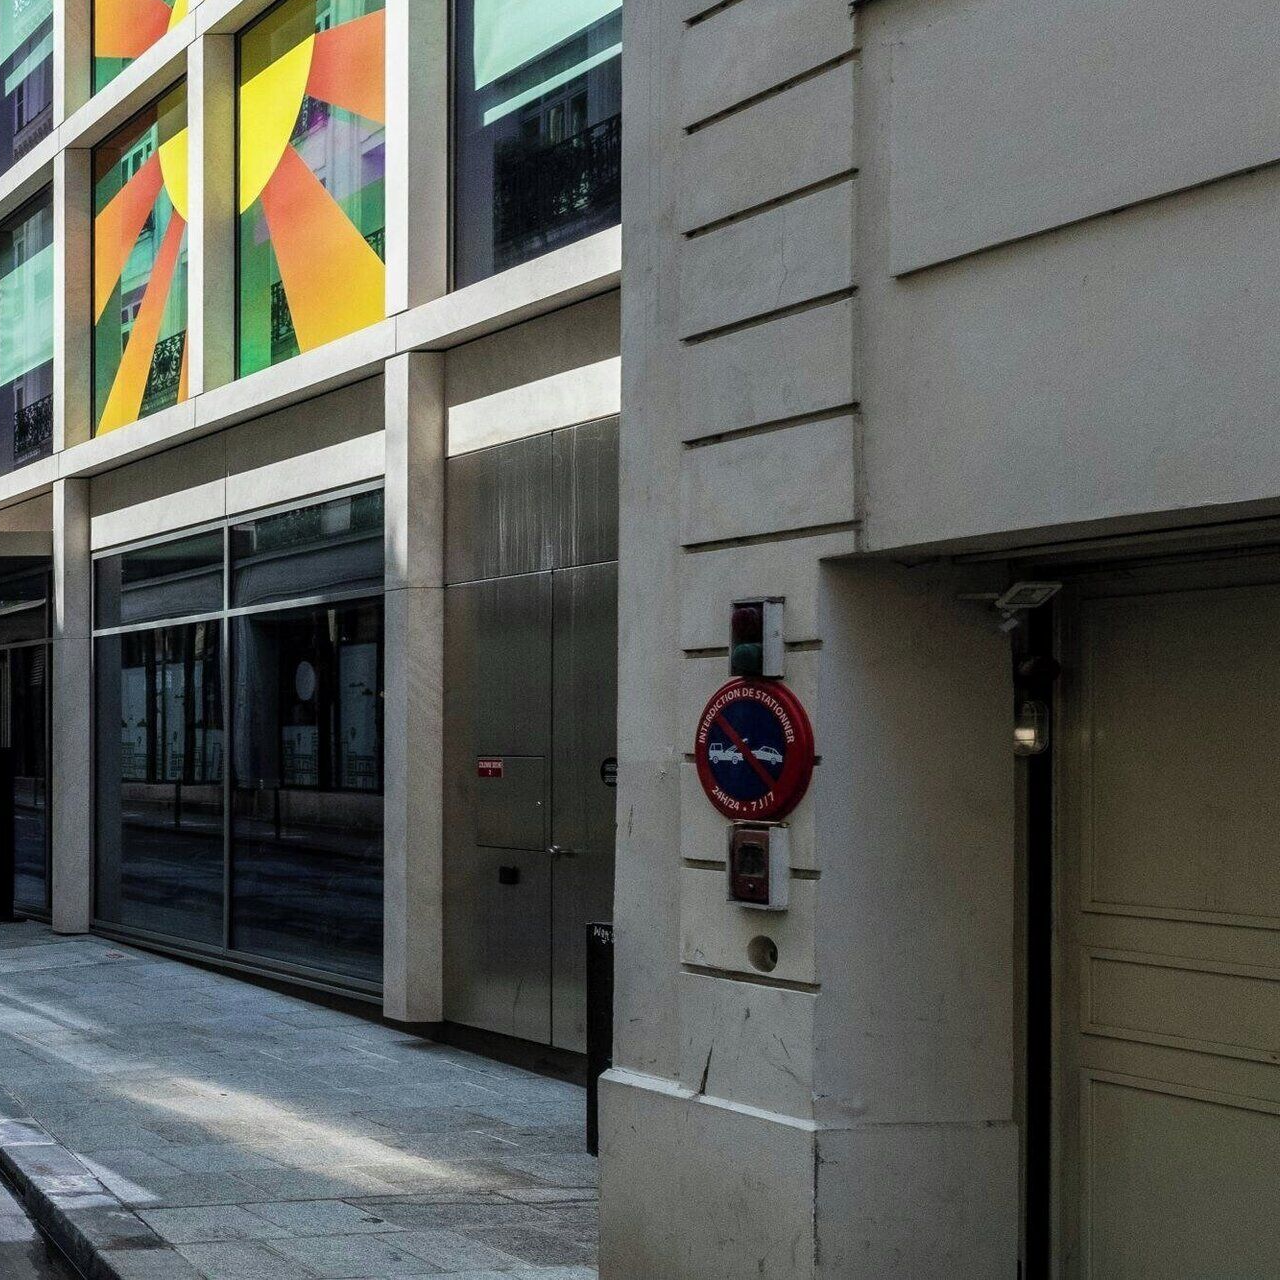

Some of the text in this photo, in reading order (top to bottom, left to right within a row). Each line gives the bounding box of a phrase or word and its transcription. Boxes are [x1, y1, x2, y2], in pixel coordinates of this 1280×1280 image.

[699, 687, 795, 744] INTERDICTION DE STATIONNER
[711, 786, 740, 811] 24H/24
